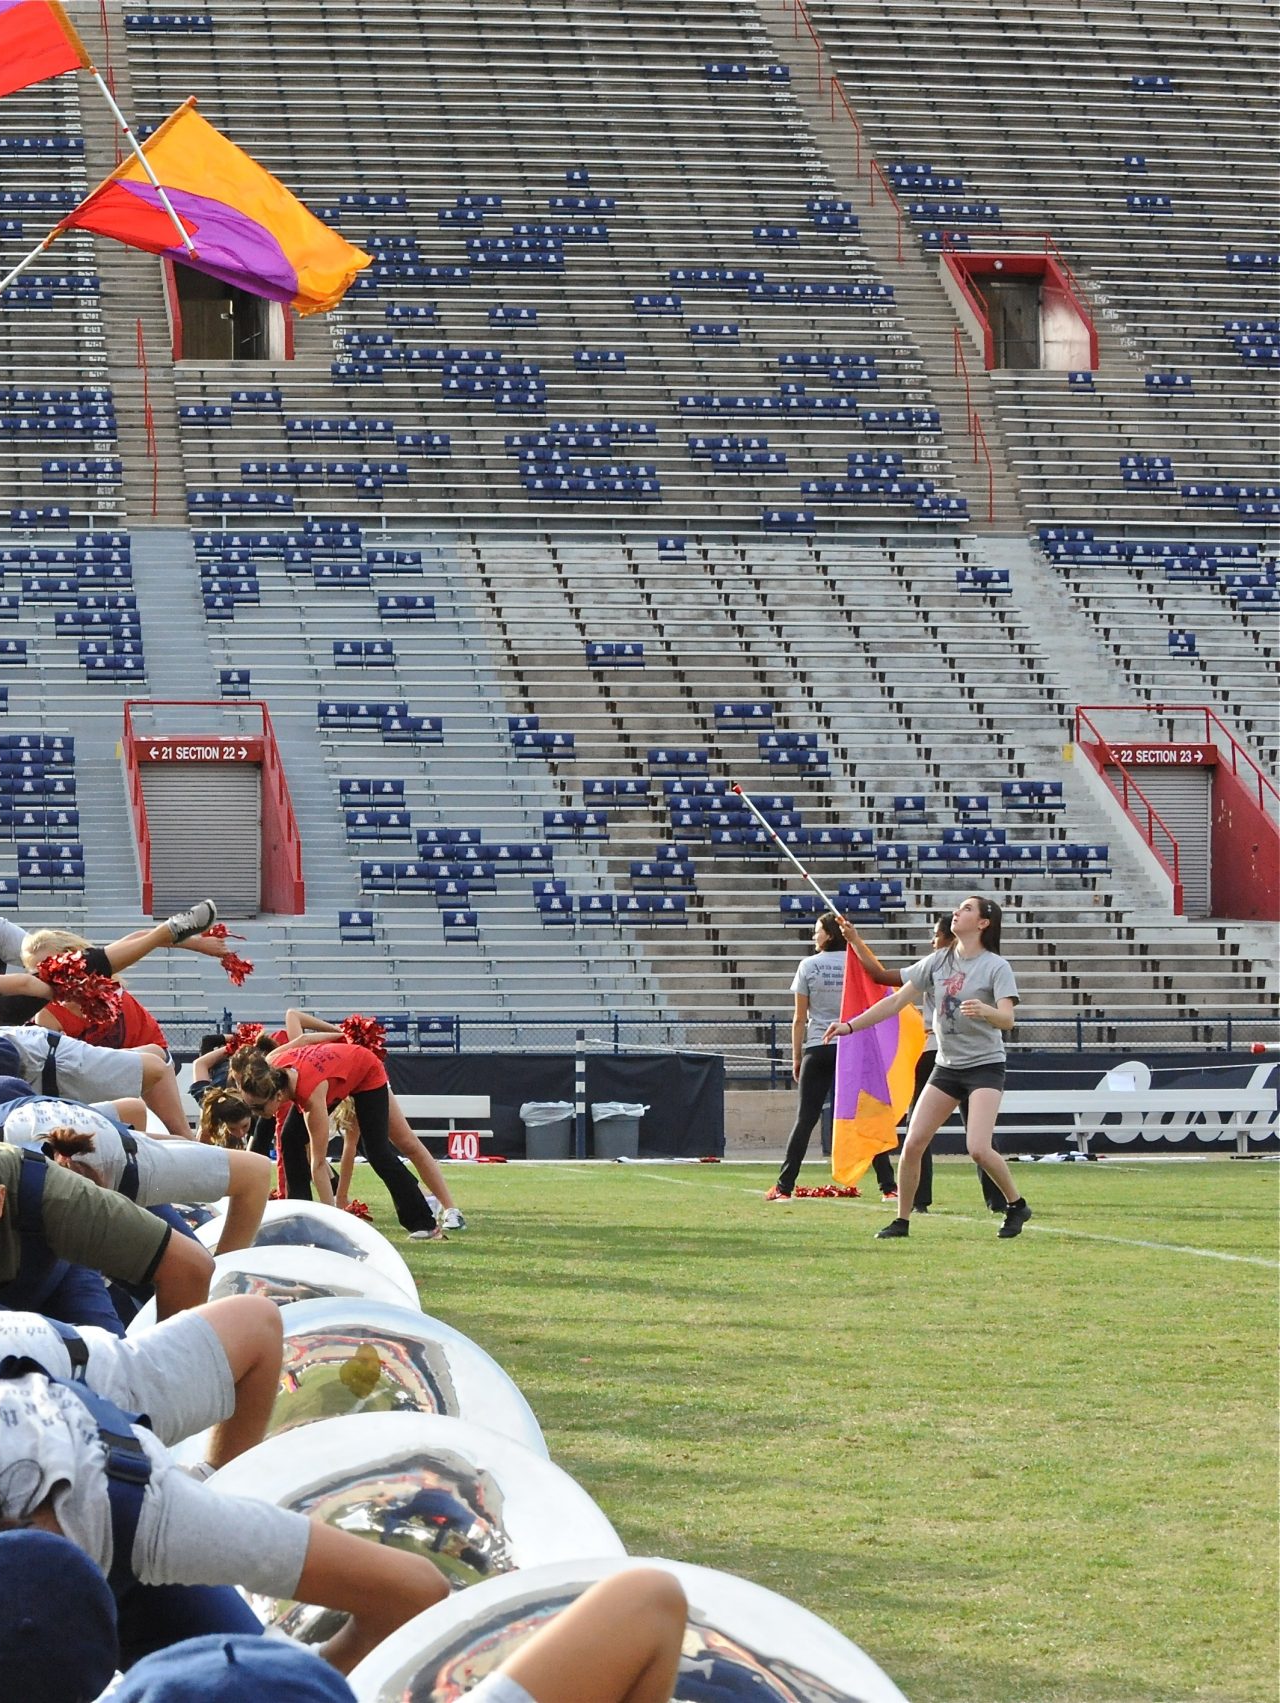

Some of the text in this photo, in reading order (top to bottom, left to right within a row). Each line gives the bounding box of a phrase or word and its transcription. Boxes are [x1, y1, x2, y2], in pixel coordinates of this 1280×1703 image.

[161, 746, 236, 760] 21 SECTION 22
[1120, 750, 1192, 763] 22 SECTION 23
[450, 1133, 478, 1160] 40
